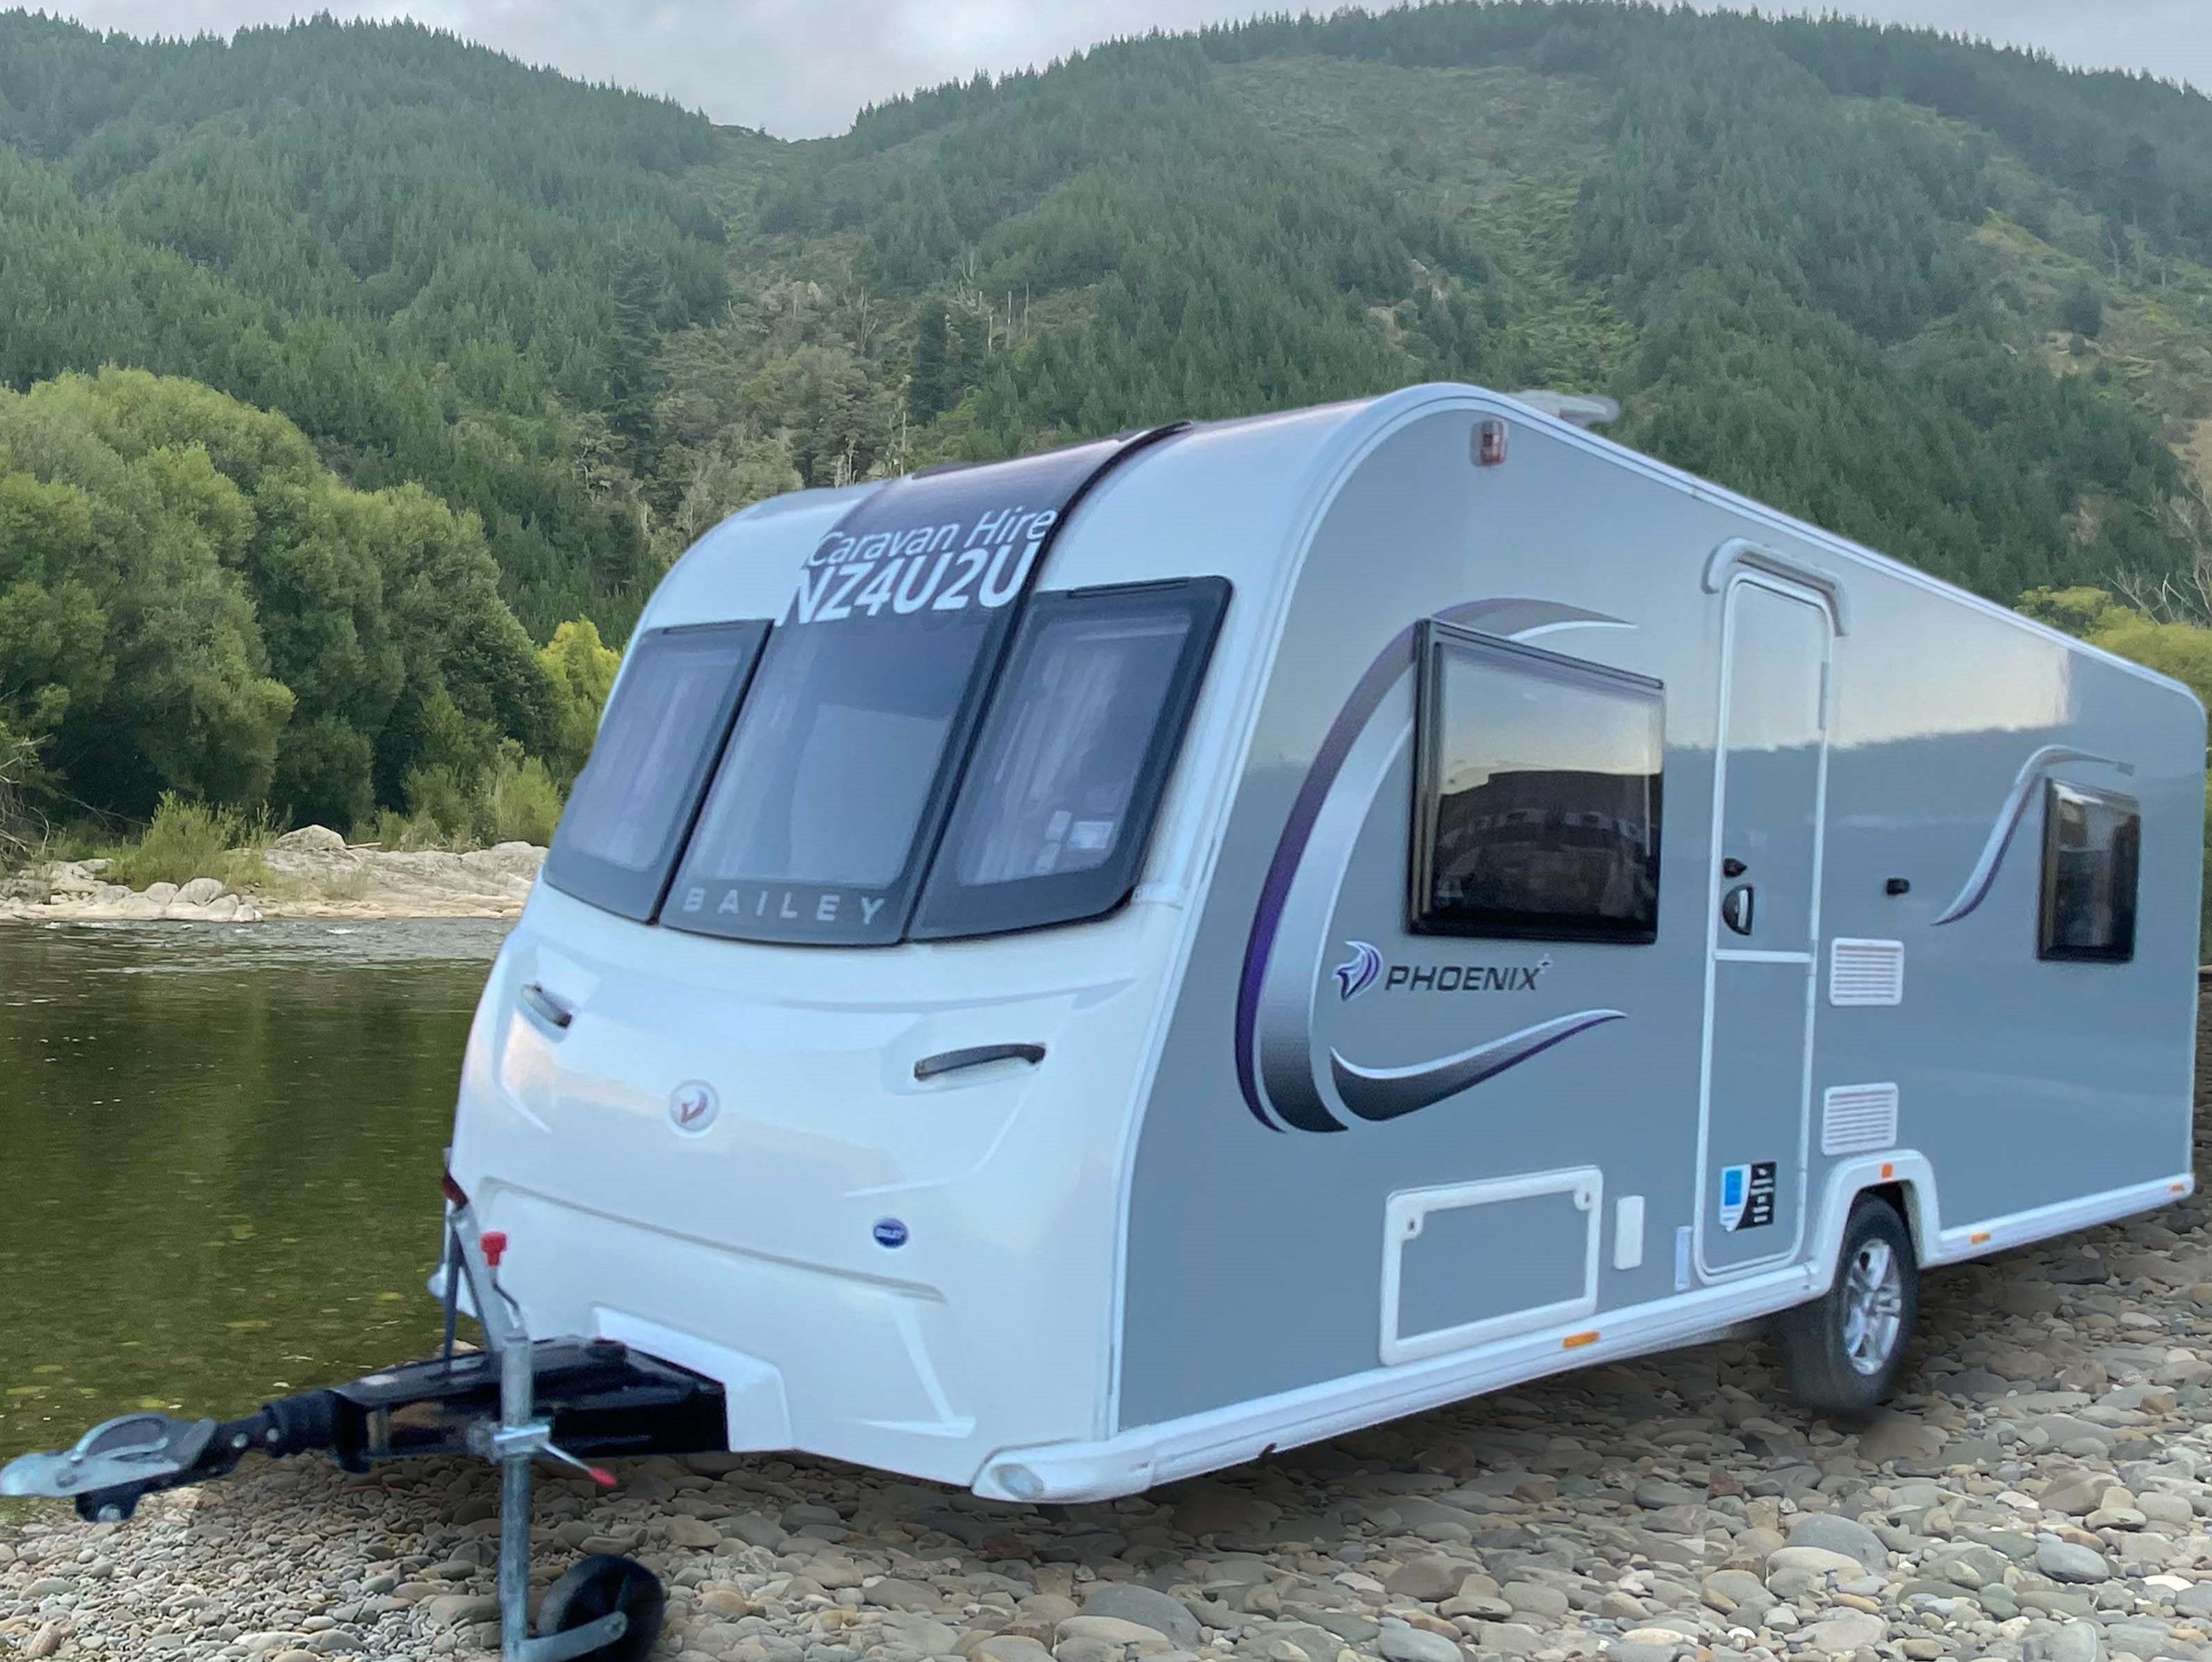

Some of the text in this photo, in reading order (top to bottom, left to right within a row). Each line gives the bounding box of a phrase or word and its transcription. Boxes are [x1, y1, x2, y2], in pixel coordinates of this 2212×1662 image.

[808, 506, 1058, 567] Caravan Hire
[774, 540, 1042, 626] NZ4U2U
[682, 887, 885, 925] BAILEY
[1384, 965, 1541, 991] PHOENIX
